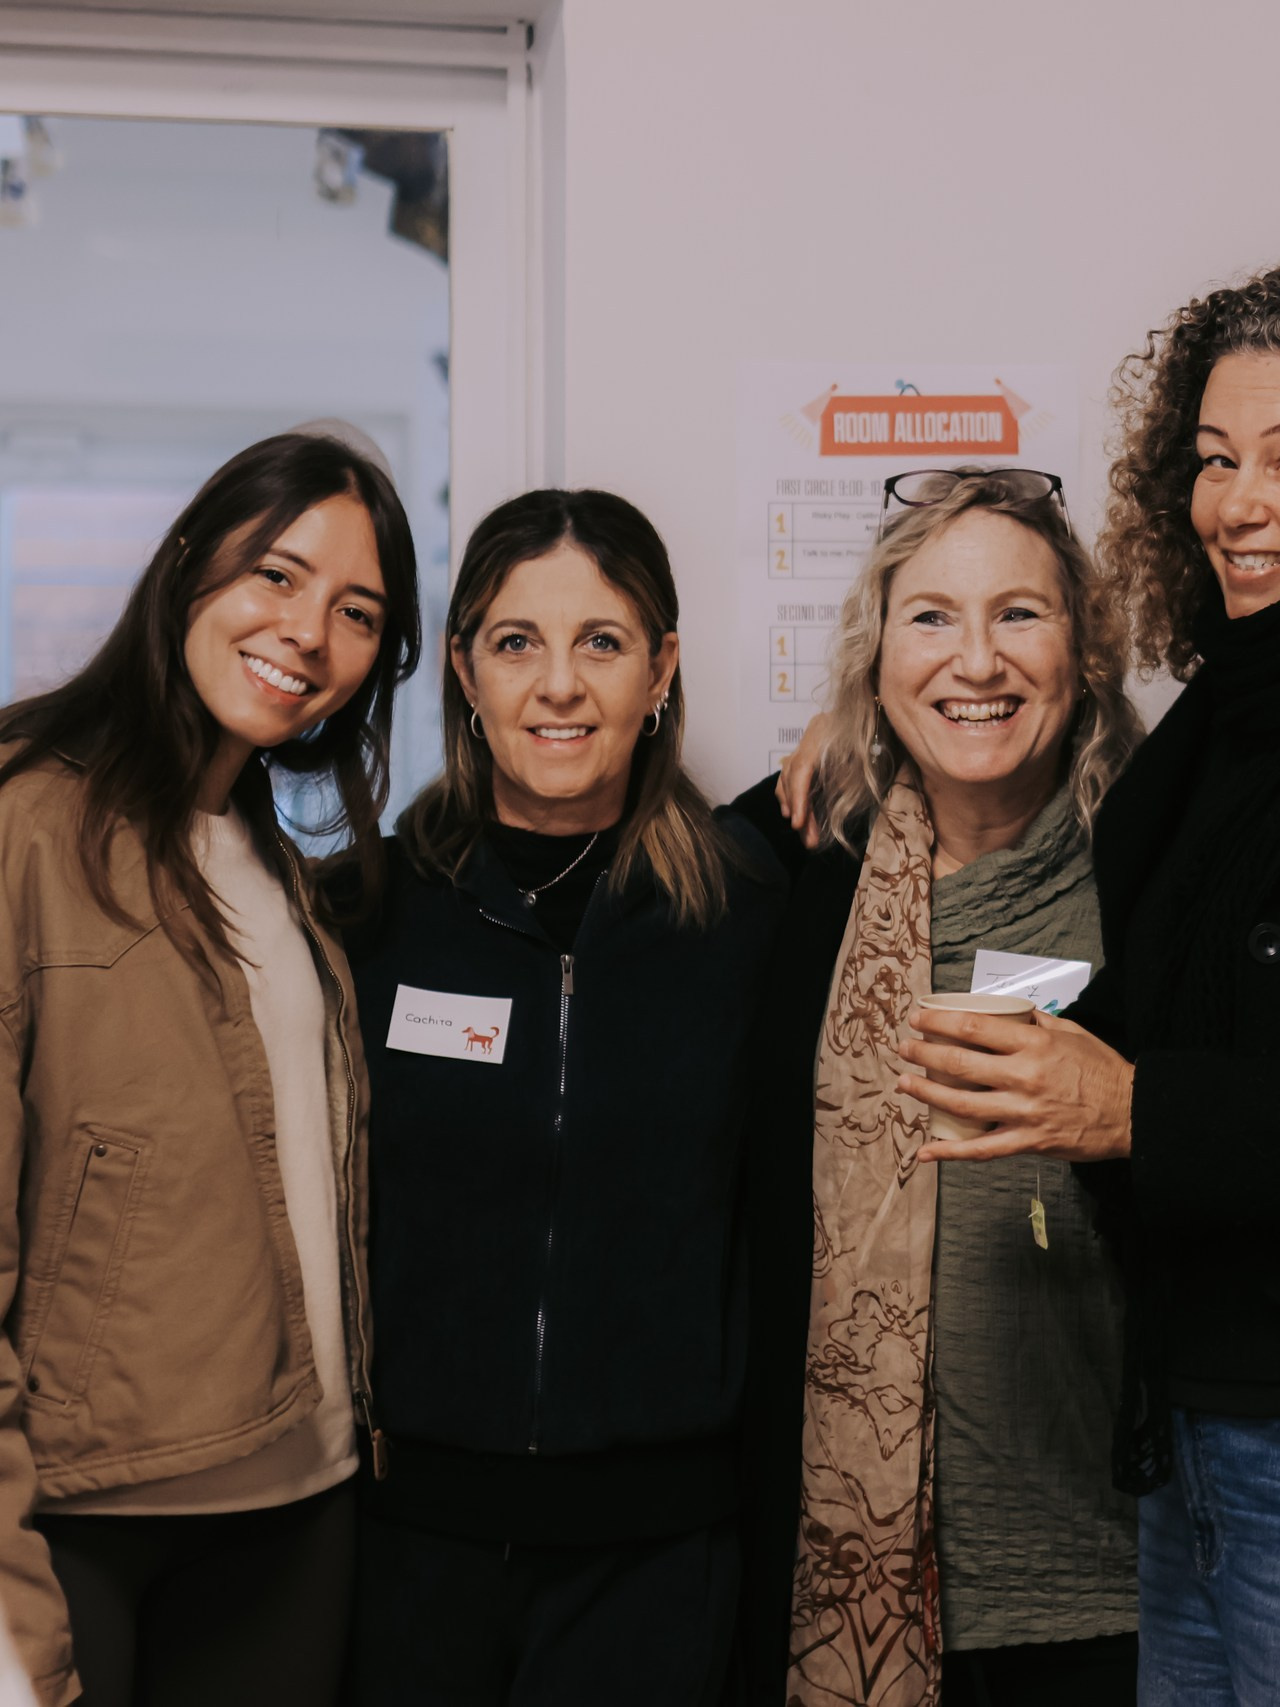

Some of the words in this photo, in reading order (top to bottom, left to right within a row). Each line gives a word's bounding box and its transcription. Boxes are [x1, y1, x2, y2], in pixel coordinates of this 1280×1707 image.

[833, 411, 890, 443] ROOM
[894, 411, 1003, 443] ALLOCATION
[776, 479, 801, 496] FIRST
[804, 479, 835, 496] CIRCLE
[776, 512, 786, 533] 1
[775, 550, 790, 570] 2
[777, 604, 815, 621] SECOND
[817, 604, 841, 621] CIRC
[776, 636, 788, 656] 1
[777, 672, 791, 693] 2
[405, 1013, 453, 1027] Cachita
